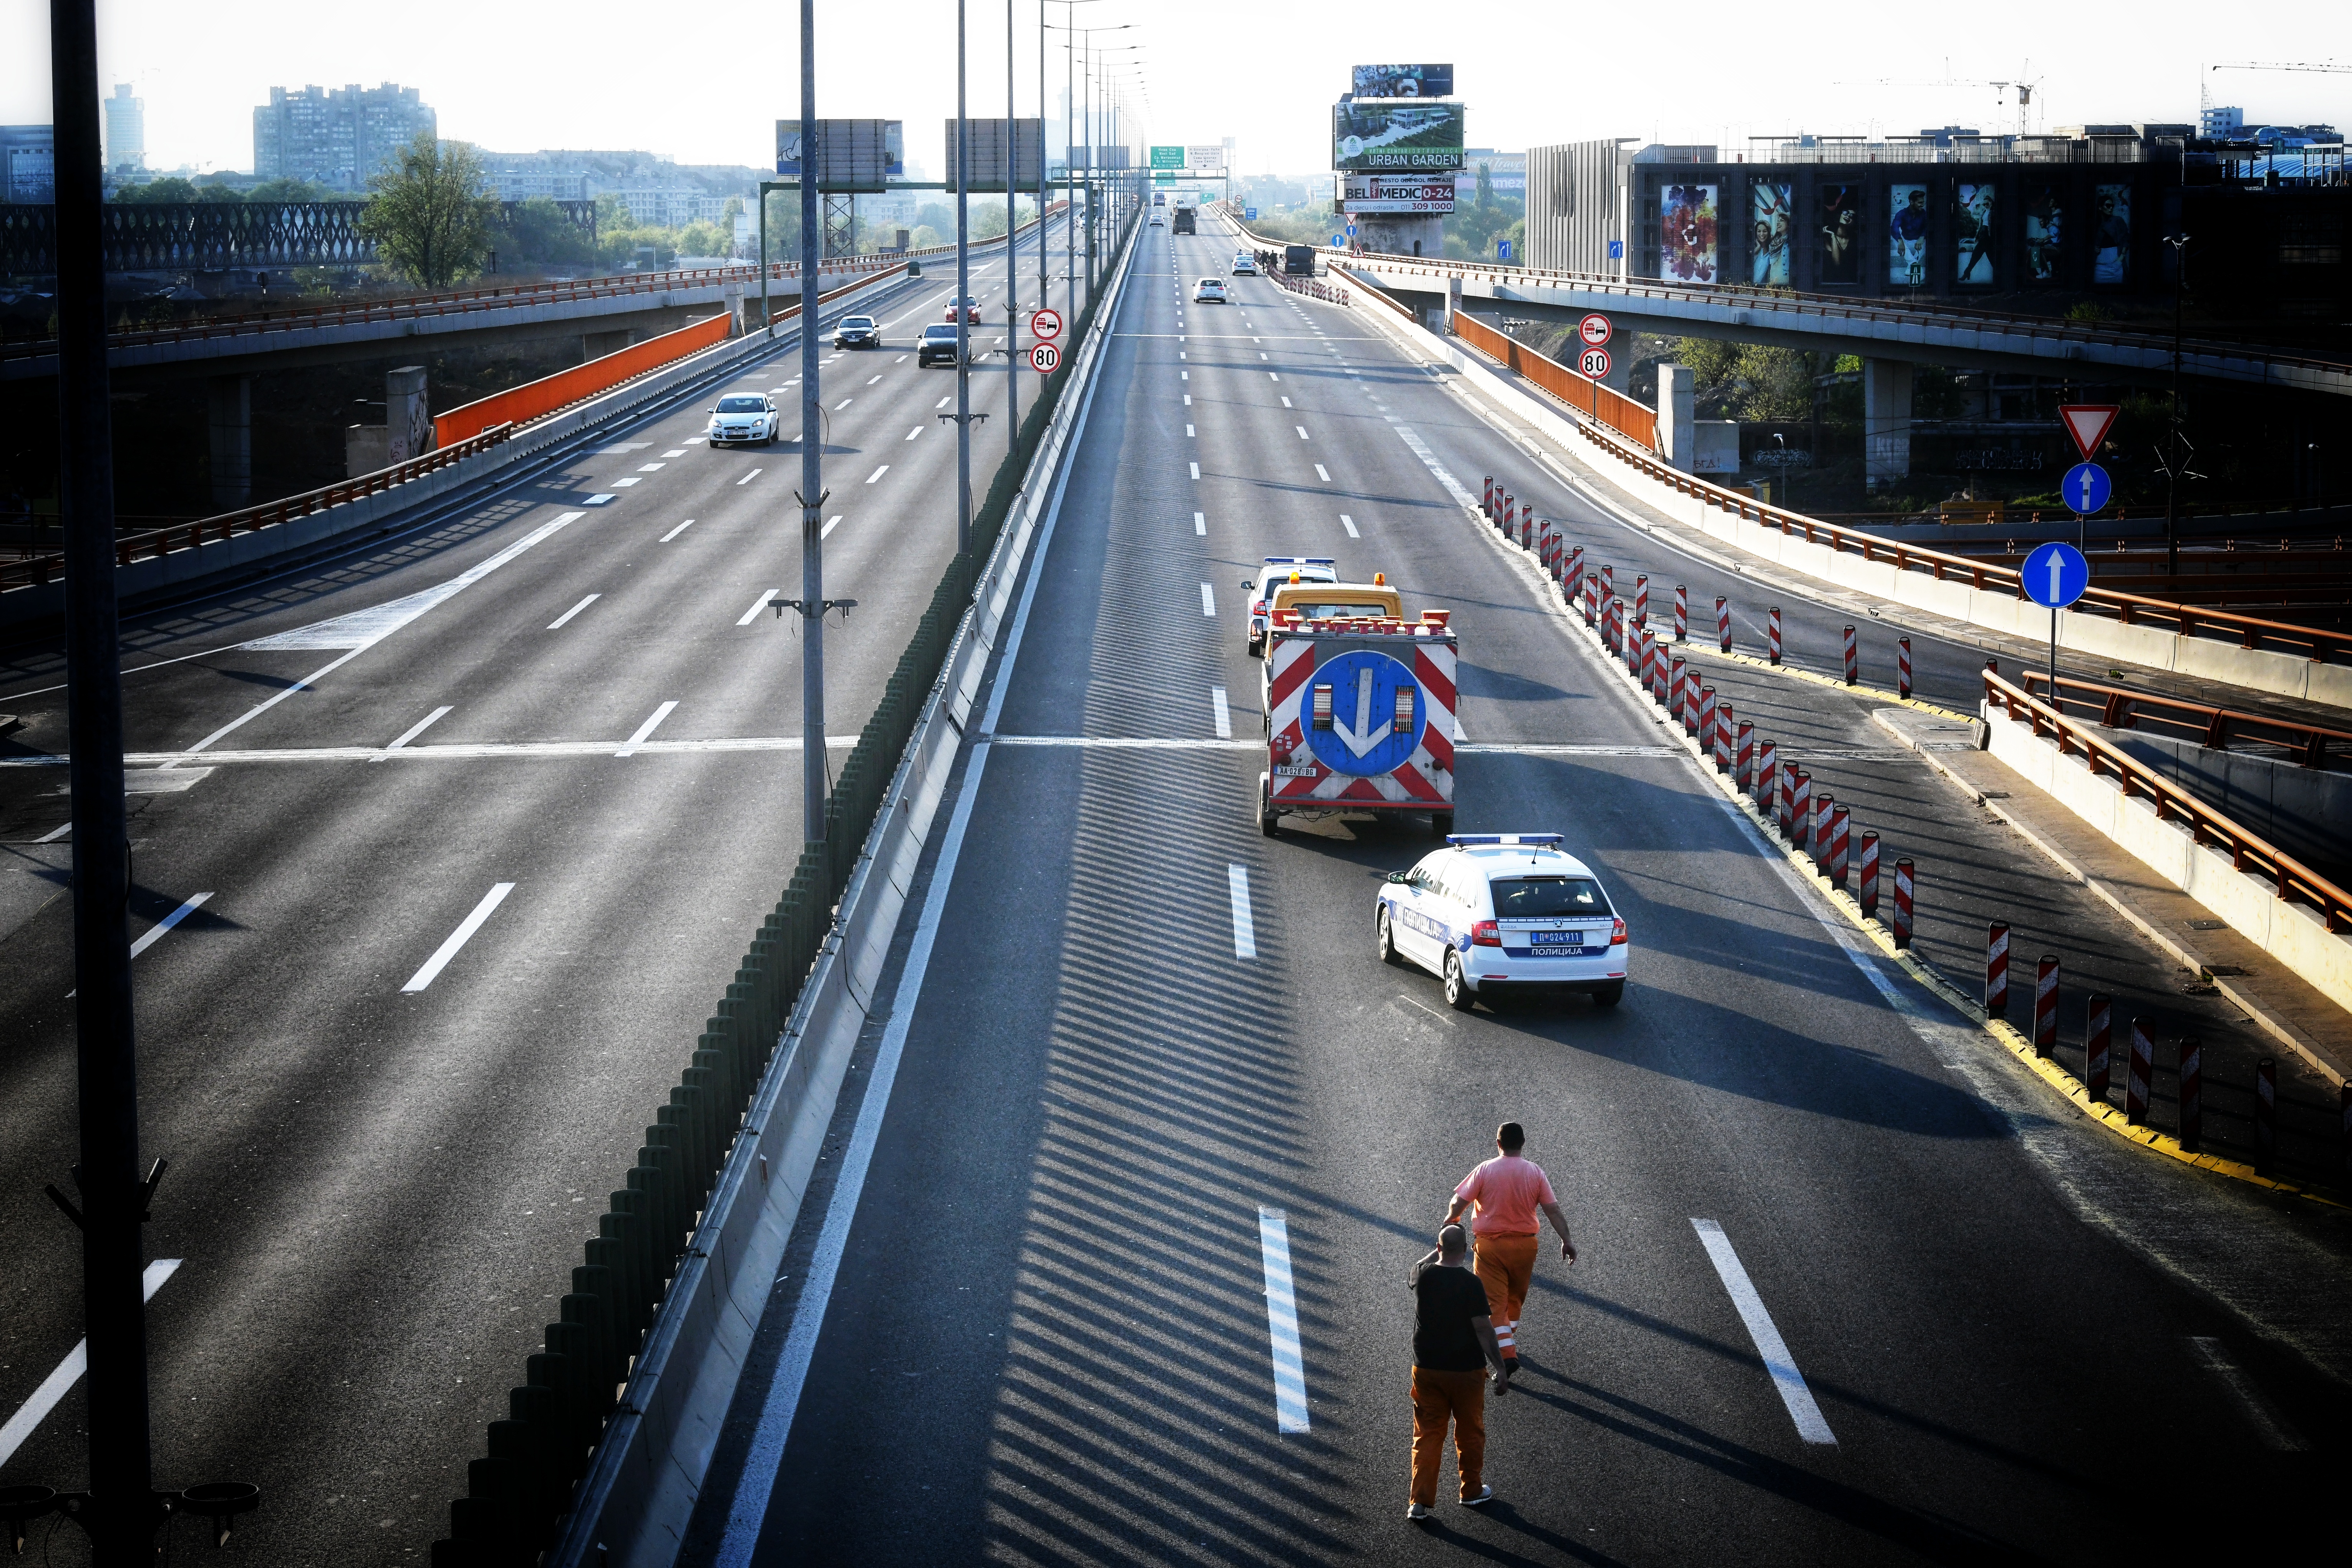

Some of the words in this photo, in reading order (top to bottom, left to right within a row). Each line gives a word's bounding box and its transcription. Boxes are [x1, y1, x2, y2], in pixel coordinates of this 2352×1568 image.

[1369, 155, 1407, 165] URBAN
[1412, 154, 1458, 165] GARDEN
[1494, 157, 1526, 167] Travel
[1346, 188, 1369, 199] BEL
[1379, 188, 1421, 199] MEDIC
[1423, 188, 1452, 198] 0-24
[1036, 350, 1054, 366] 80
[1585, 355, 1604, 371] 80
[1404, 908, 1438, 938] ПОЛИЦИЈА
[1532, 948, 1582, 956] ПОЛИЦИЈА
